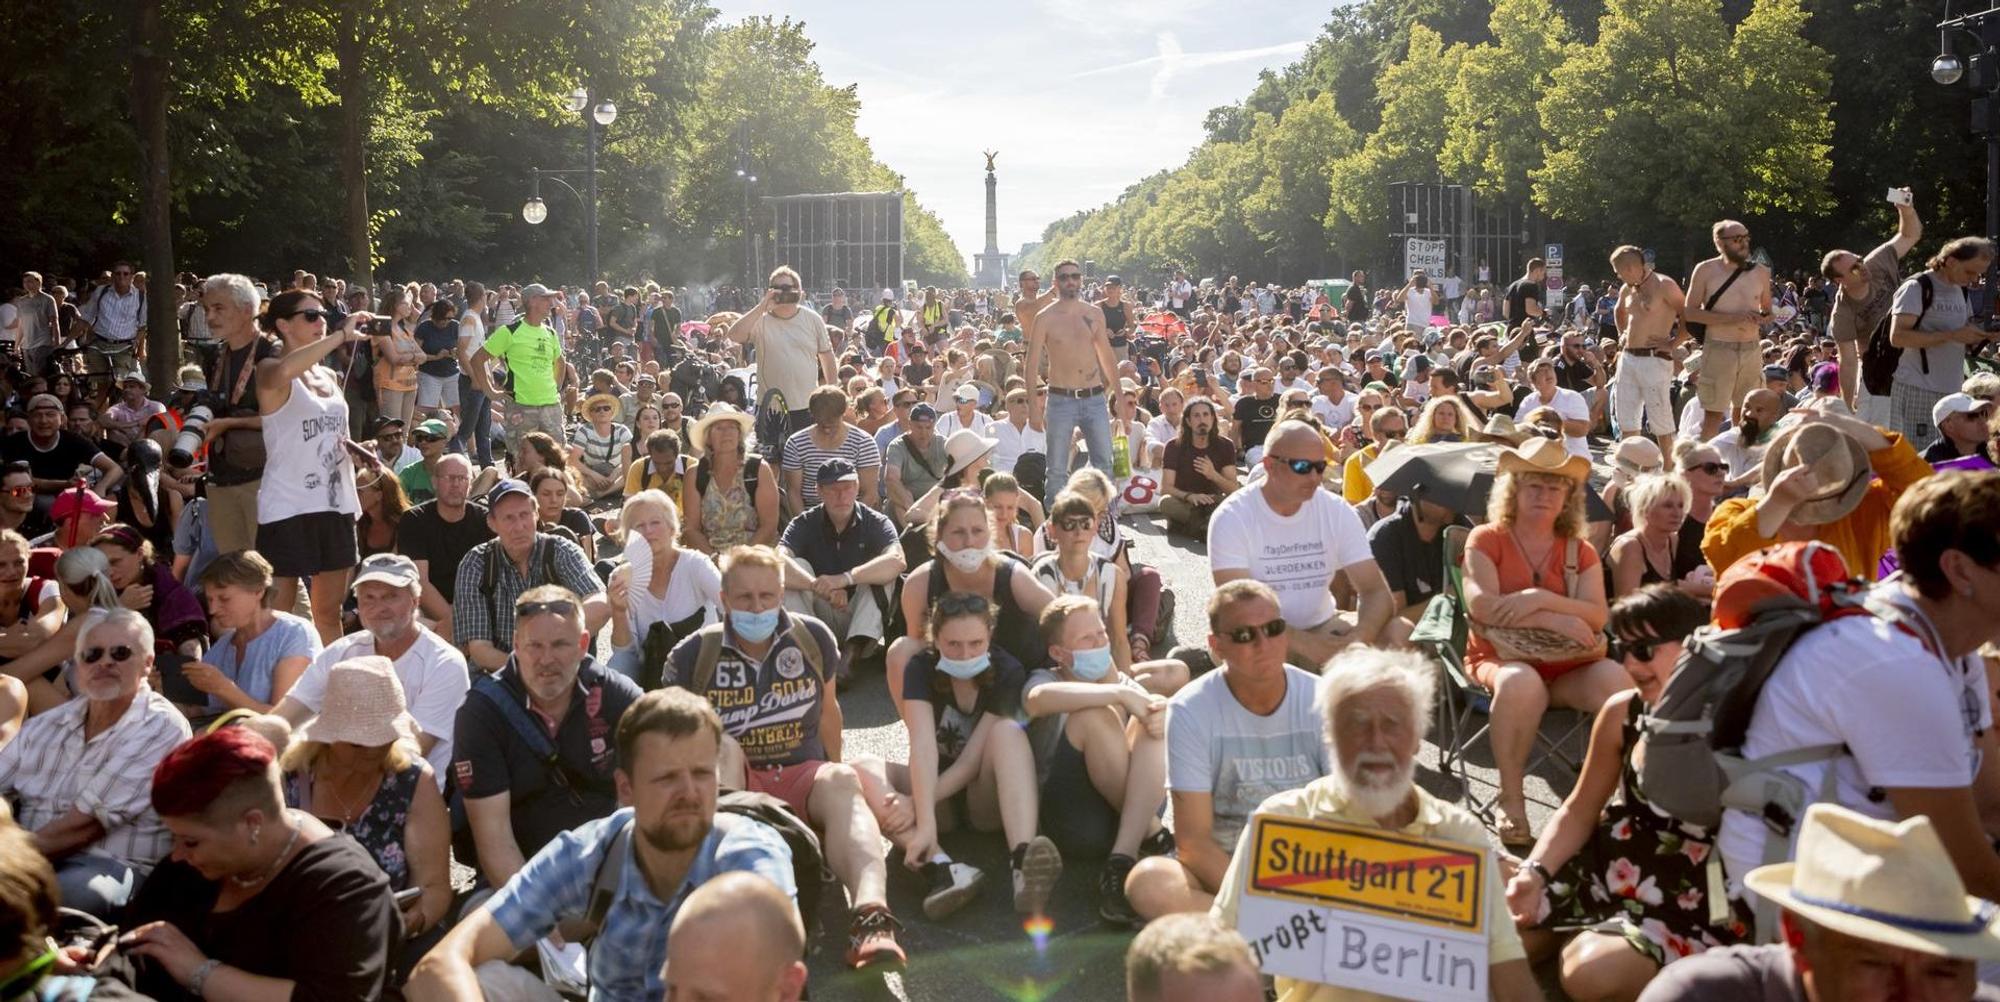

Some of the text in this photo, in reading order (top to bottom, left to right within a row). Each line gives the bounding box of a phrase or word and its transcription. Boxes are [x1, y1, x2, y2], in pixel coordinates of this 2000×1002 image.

[1409, 241, 1446, 252] STOPP
[1548, 246, 1558, 258] P
[1409, 254, 1445, 265] CHEM-
[1409, 266, 1444, 278] TILS
[716, 661, 747, 688] 63
[707, 686, 755, 708] FIELD
[1232, 754, 1311, 781] VISIONS
[1268, 838, 1466, 904] Stuttgart 21
[1338, 925, 1476, 991] Berlin
